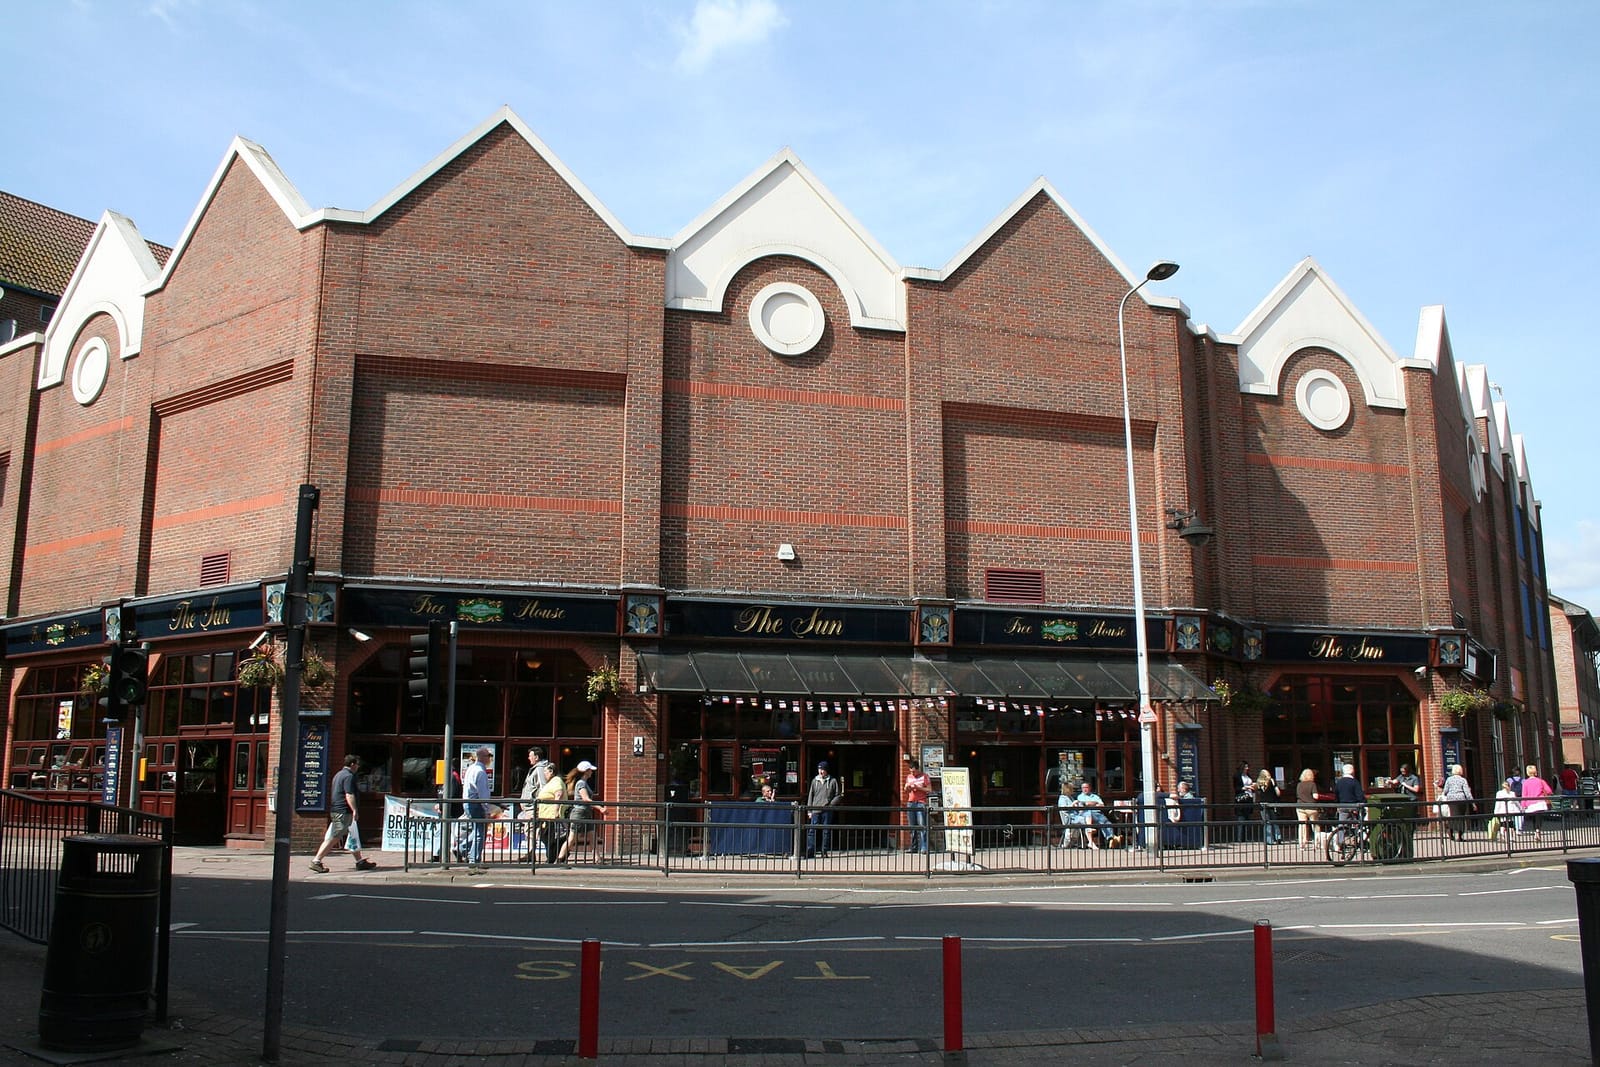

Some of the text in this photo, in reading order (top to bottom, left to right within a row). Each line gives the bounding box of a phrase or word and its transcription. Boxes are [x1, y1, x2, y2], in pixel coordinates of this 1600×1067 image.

[168, 596, 231, 631] The Sun
[410, 594, 566, 620] Free House
[733, 605, 844, 638] The Sun
[1003, 616, 1127, 639] Free House
[1308, 634, 1385, 662] The Sun
[388, 814, 438, 831] BREAKFA
[514, 960, 871, 982] TAXS
